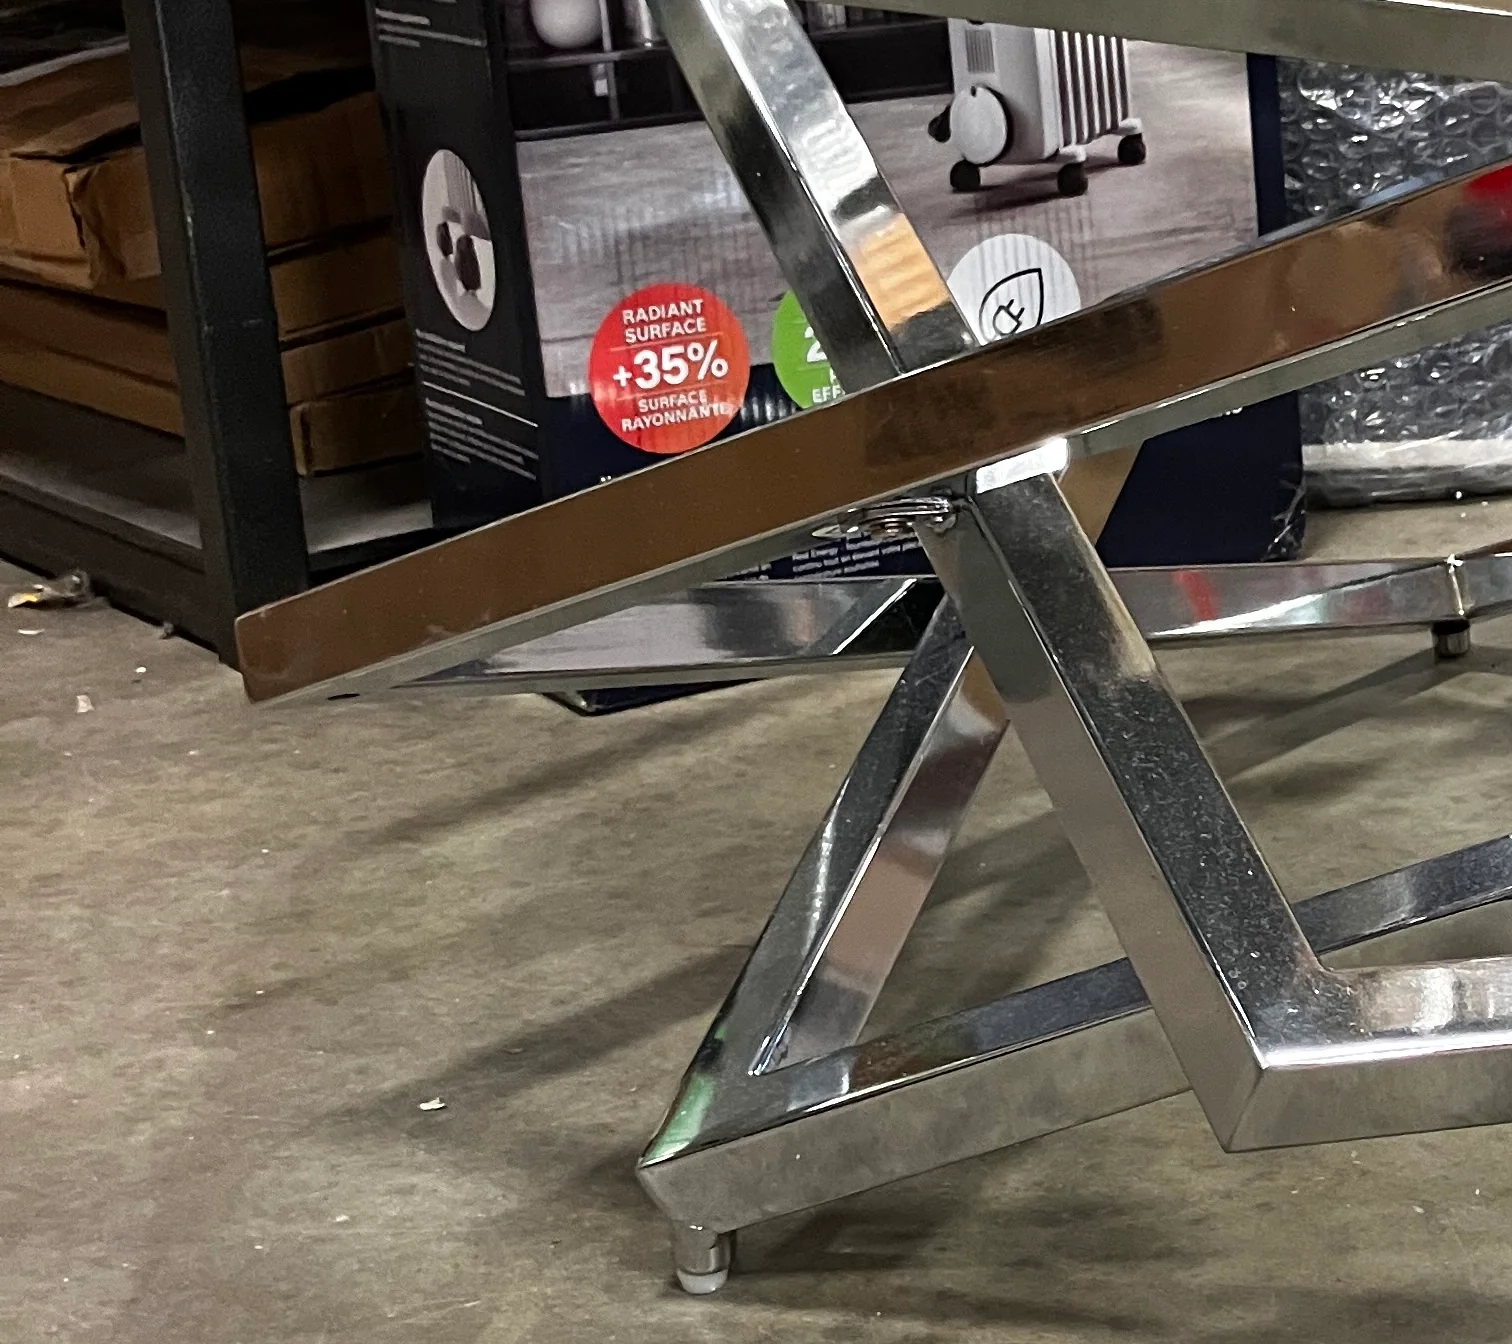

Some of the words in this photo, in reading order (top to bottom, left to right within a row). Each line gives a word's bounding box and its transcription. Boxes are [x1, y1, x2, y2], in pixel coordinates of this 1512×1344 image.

[621, 298, 704, 325] RADIANT
[624, 317, 708, 344] SURFACE
[612, 339, 729, 390] +35%
[638, 389, 708, 413] SURFACE
[620, 403, 736, 433] RAYONNANTE
